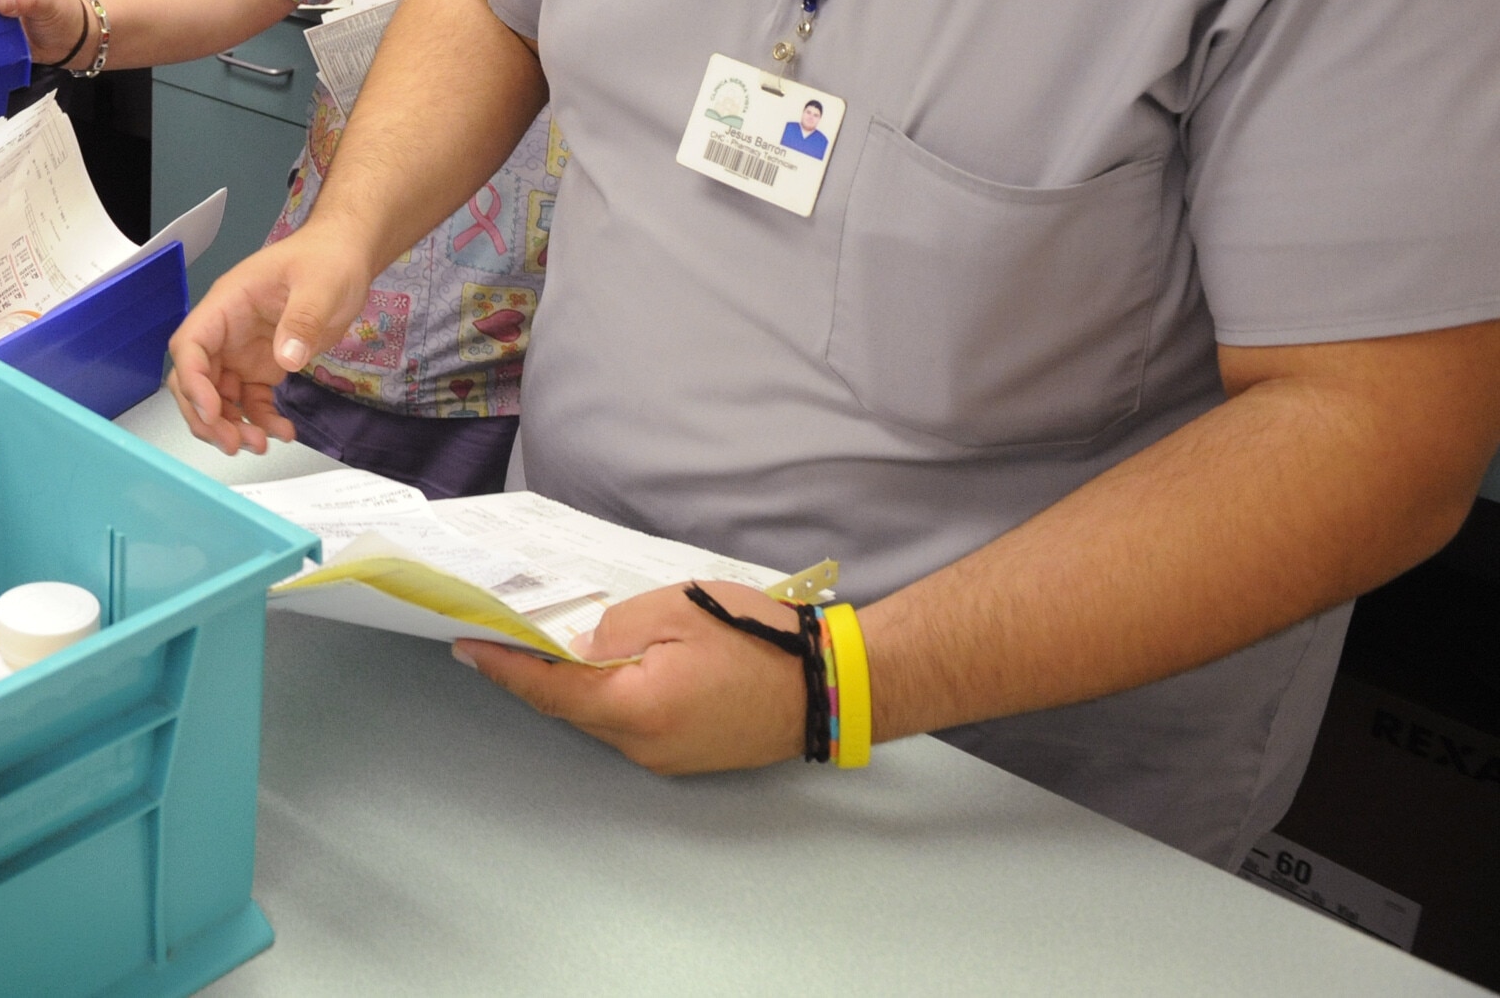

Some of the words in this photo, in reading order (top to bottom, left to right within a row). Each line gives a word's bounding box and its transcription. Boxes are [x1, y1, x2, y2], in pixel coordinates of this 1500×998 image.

[725, 125, 753, 144] Jesus
[754, 136, 787, 157] Barron
[1275, 850, 1312, 885] 60
